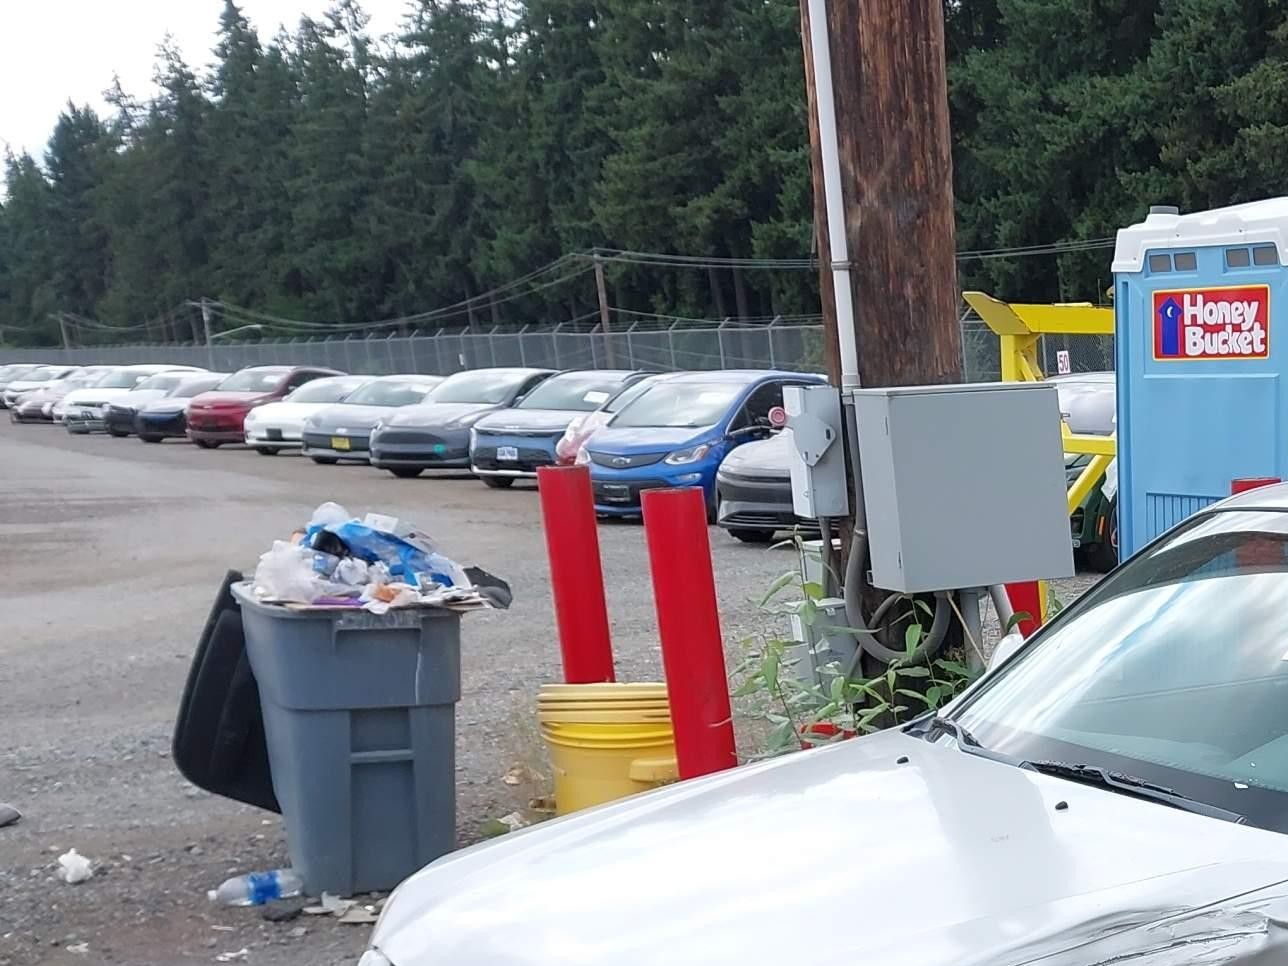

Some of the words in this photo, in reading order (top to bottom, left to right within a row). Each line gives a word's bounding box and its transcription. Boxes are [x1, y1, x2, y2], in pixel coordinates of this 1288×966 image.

[1183, 293, 1260, 328] Honey
[1184, 322, 1266, 356] Bucket
[1058, 354, 1069, 372] 50
